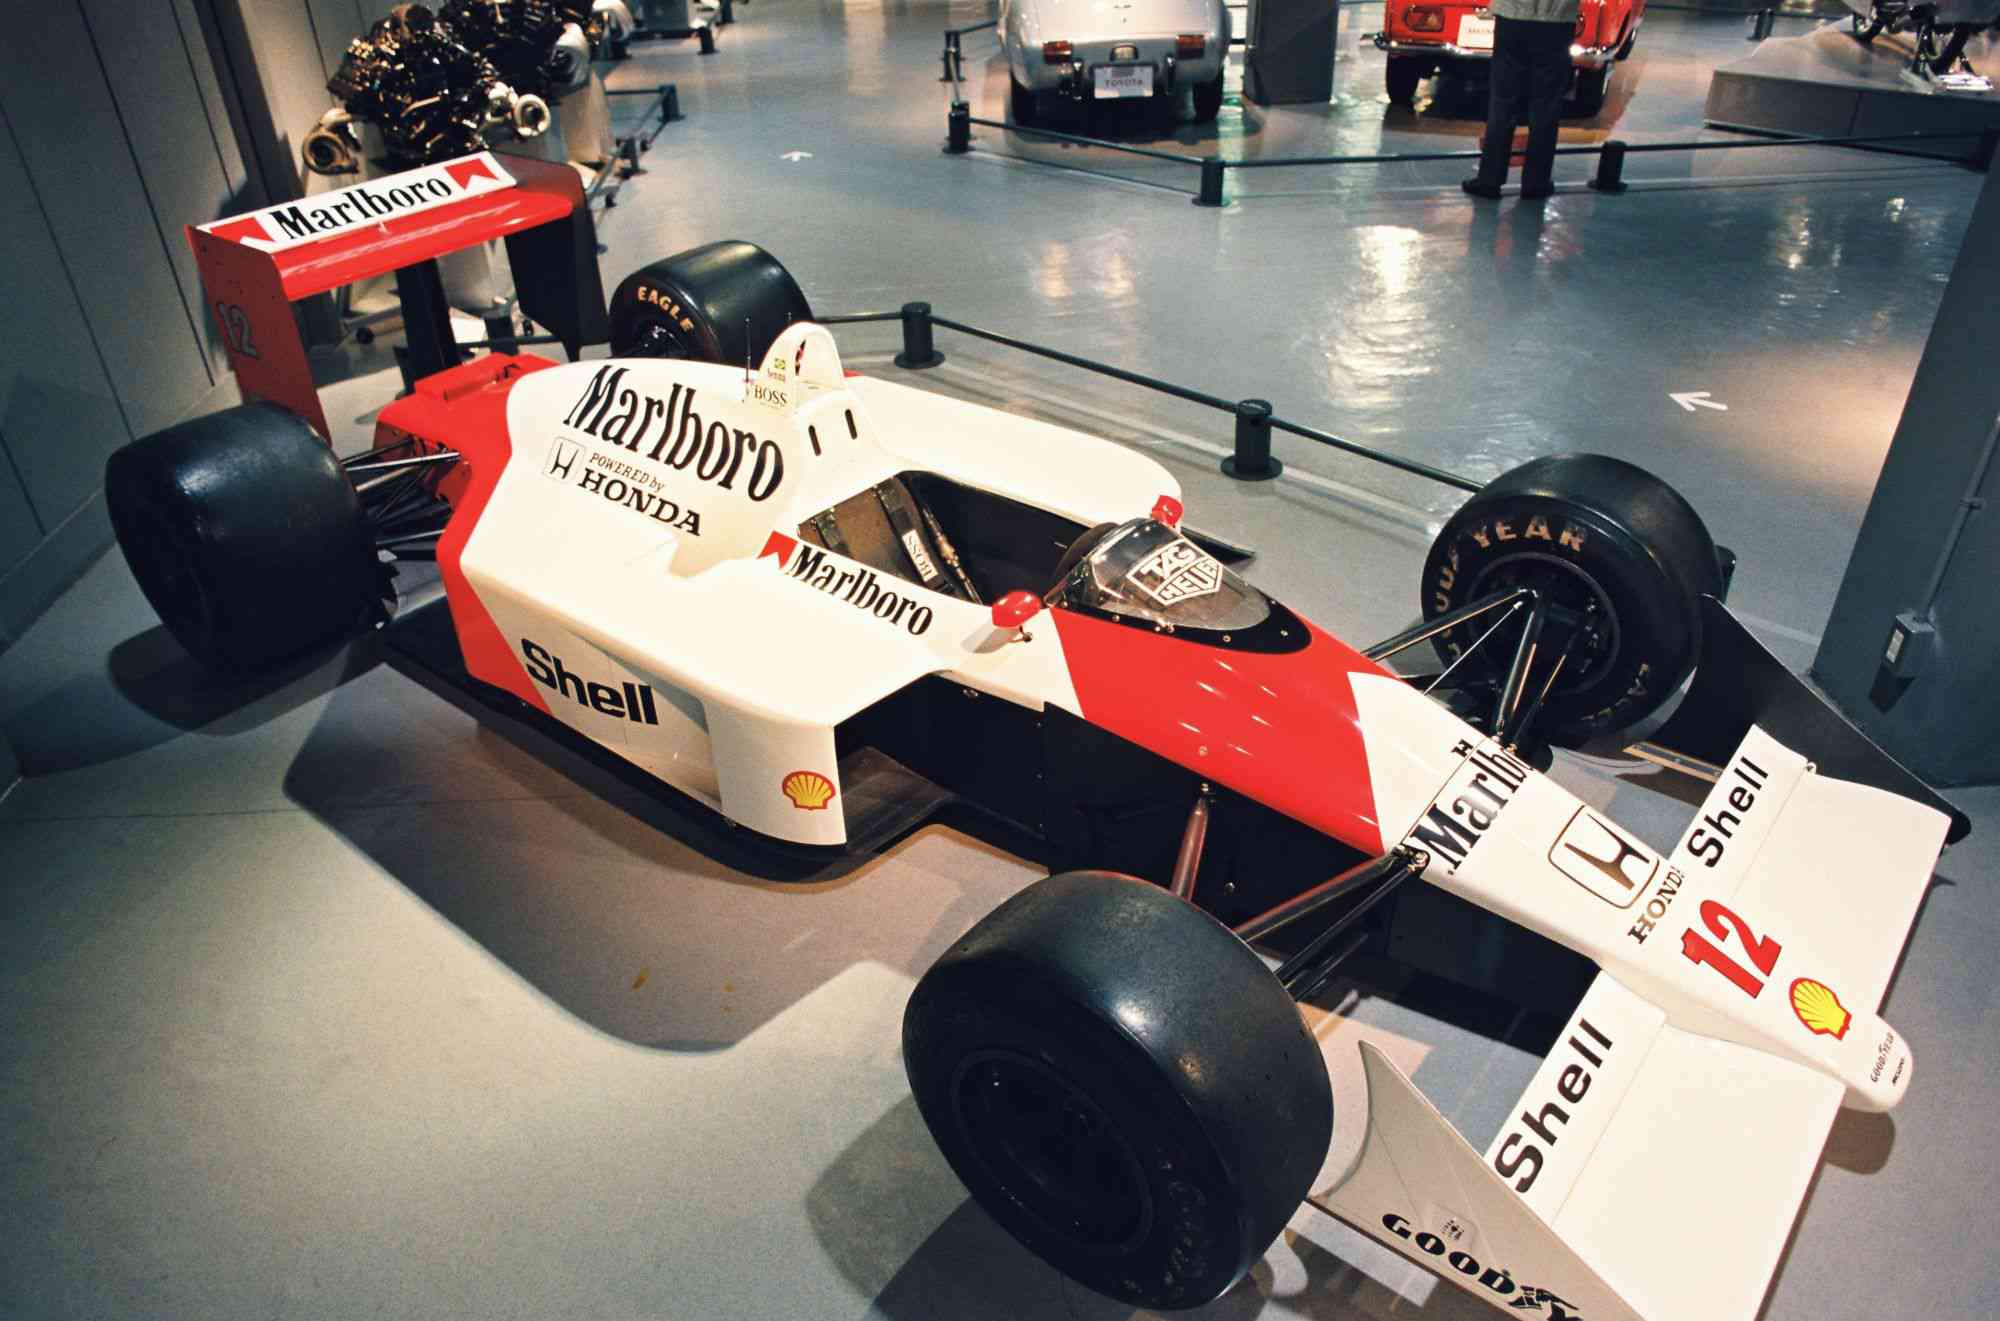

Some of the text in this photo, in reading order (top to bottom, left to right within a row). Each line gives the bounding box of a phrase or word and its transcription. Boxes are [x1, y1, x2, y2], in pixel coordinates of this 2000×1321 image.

[269, 177, 453, 240] Marlboro
[637, 286, 695, 332] EAGLE
[754, 384, 788, 405] BOSS
[563, 365, 784, 502] Marlboro
[577, 467, 701, 537] HONDA
[589, 452, 666, 493] POWERED by
[1139, 546, 1197, 580] TAG
[1472, 517, 1584, 552] YEAR
[784, 544, 933, 636] Marlboro
[521, 638, 659, 726] Shell
[1687, 755, 1769, 868] Shell
[1627, 865, 1686, 945] HOND
[1680, 899, 1782, 999] 12
[1494, 1017, 1613, 1194] Shell
